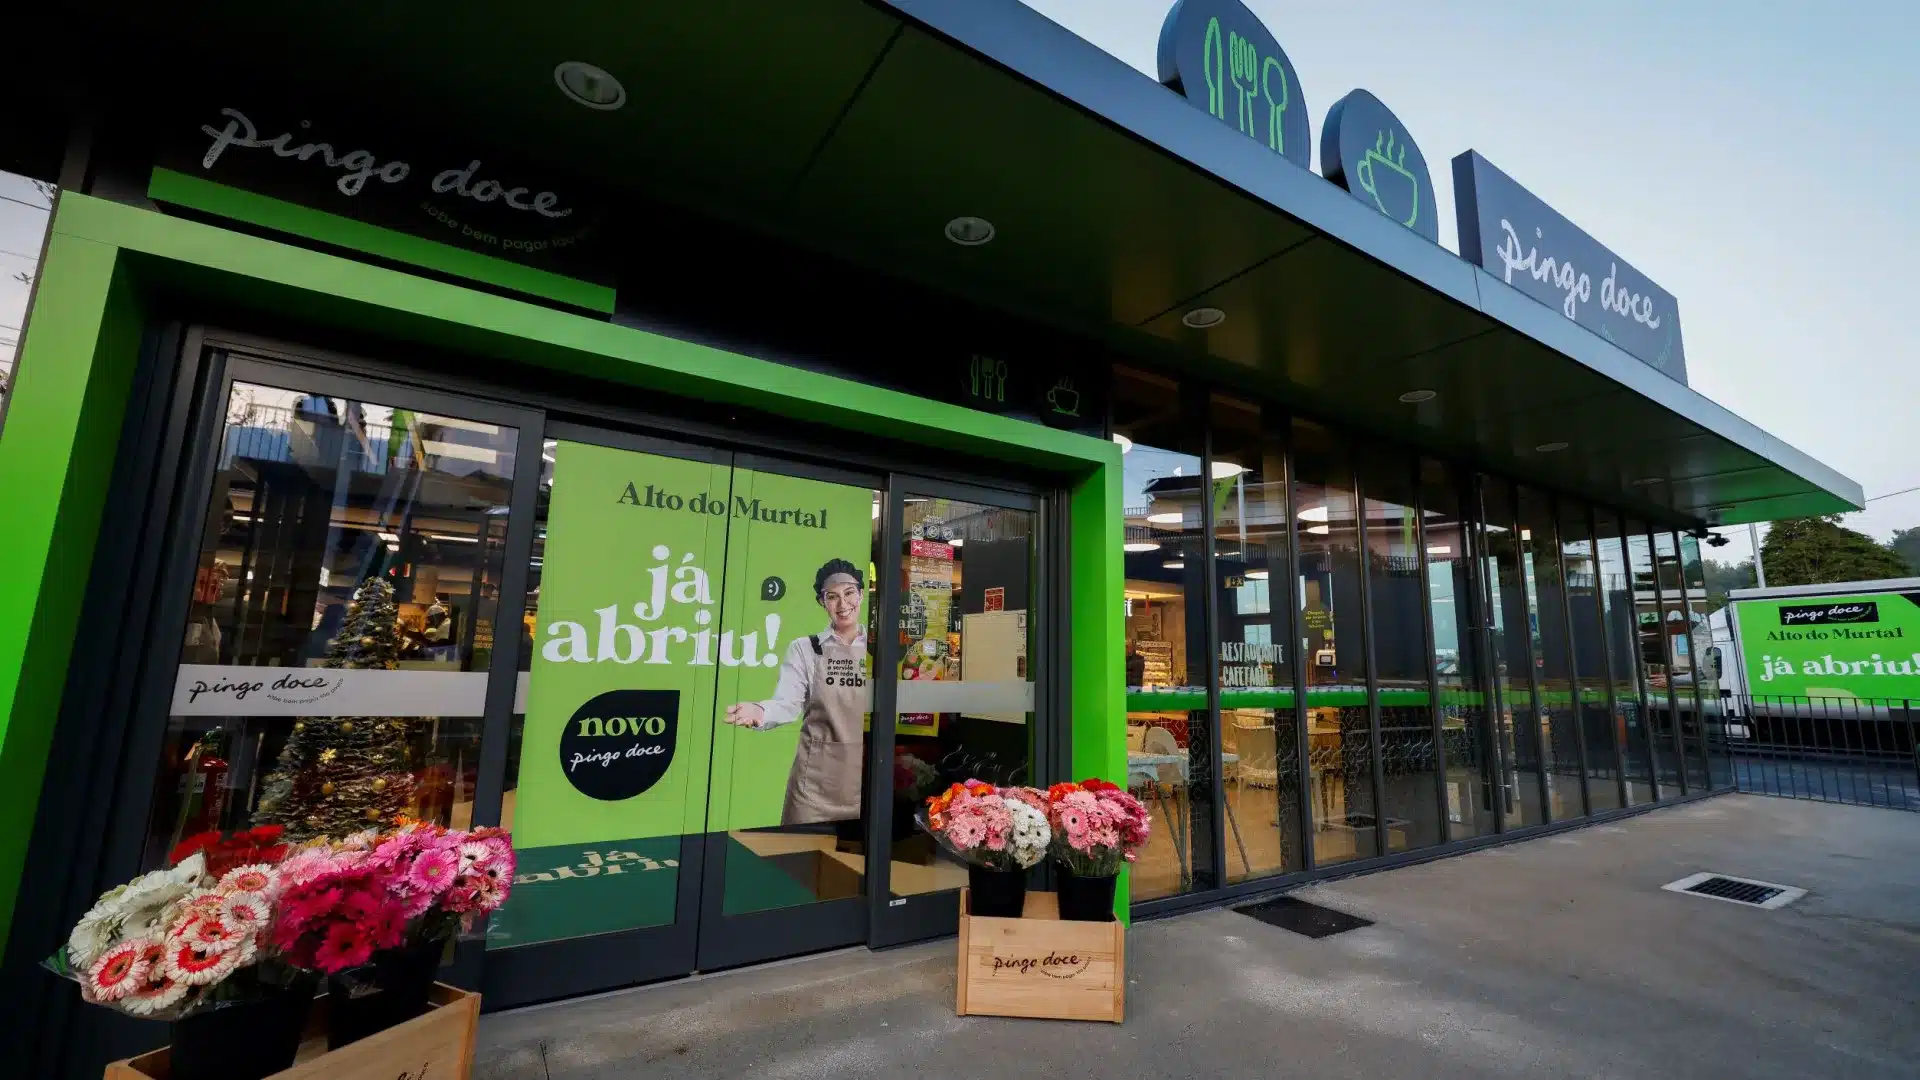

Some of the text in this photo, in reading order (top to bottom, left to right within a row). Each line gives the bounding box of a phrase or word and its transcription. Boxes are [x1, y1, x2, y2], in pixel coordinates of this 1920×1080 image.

[200, 108, 573, 218] pingo doce
[1496, 218, 1661, 329] pingo doce
[616, 480, 829, 530] Alto do Murtal
[633, 544, 715, 621] já
[1783, 609, 1824, 624] pingo
[1827, 605, 1864, 616] doce
[541, 603, 781, 668] abriu!
[1766, 626, 1905, 641] Alto do Murtal
[825, 673, 866, 688] o sab
[1759, 654, 1797, 682] já
[188, 673, 330, 704] pingo doce
[576, 716, 666, 737] novo
[569, 743, 666, 773] pingo doce
[992, 953, 1038, 977] pingo
[1042, 951, 1080, 966] doce
